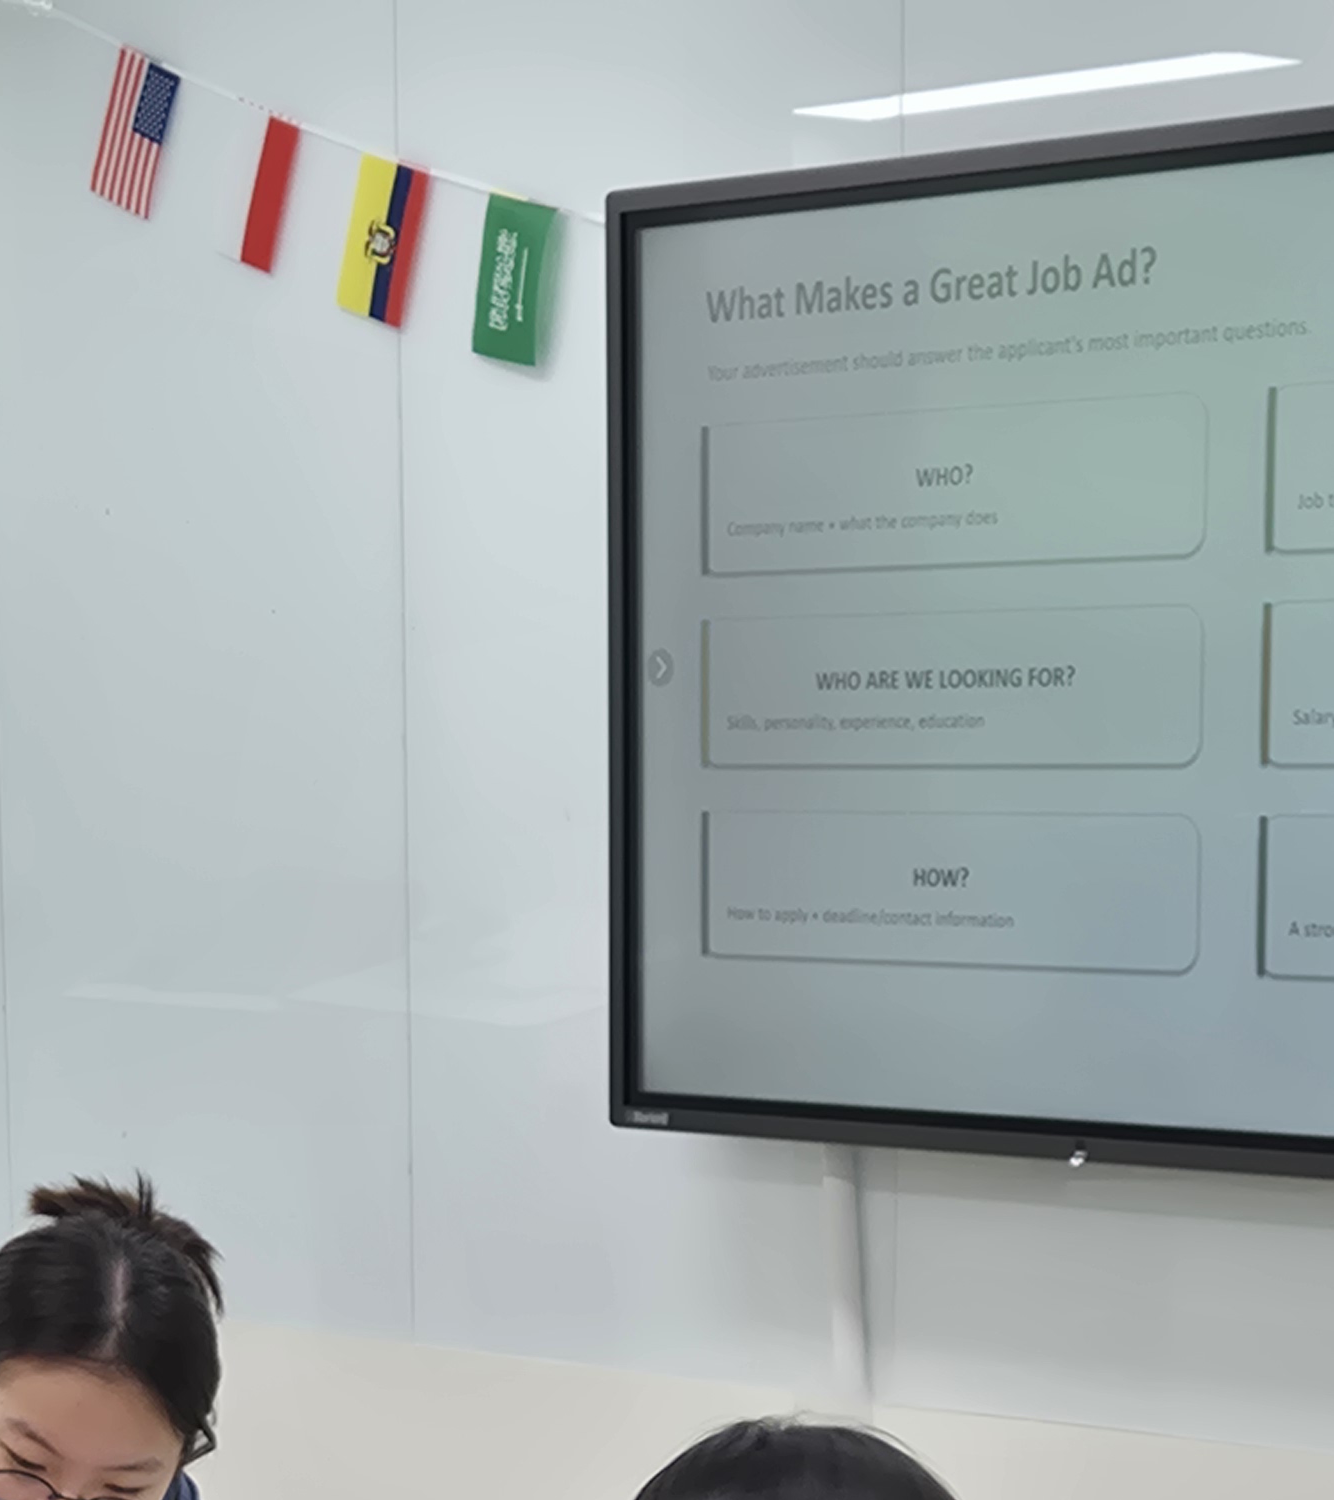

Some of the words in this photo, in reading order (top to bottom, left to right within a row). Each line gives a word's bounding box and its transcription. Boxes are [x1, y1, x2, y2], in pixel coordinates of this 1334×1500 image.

[706, 286, 785, 323] What
[794, 277, 893, 316] Makes
[902, 280, 919, 307] a
[929, 264, 1018, 304] Great
[1026, 253, 1083, 297] Job
[1092, 246, 1159, 290] Ad?
[707, 364, 739, 382] Your
[741, 354, 849, 379] advertisement
[852, 350, 904, 372] should
[908, 349, 963, 367] answer
[966, 345, 995, 363] the
[997, 334, 1084, 362] applicant's
[1088, 332, 1130, 351] most
[1133, 327, 1218, 355] important
[1223, 319, 1312, 344] questions.
[915, 463, 974, 488] WHO?
[1297, 491, 1324, 510] Job
[727, 521, 785, 538] Company
[788, 520, 824, 533] name
[839, 516, 871, 530] what
[875, 514, 897, 529] the
[900, 514, 962, 531] company
[965, 510, 998, 526] does
[815, 671, 861, 691] WHO
[865, 670, 899, 690] ARE
[904, 669, 934, 689] WE
[939, 667, 1023, 688] LOOKING
[1028, 664, 1075, 688] FOR?
[764, 714, 835, 732] personality,
[839, 715, 915, 732] experience,
[918, 714, 985, 729] education
[912, 866, 969, 888] HOW?
[727, 906, 755, 921] How
[758, 907, 771, 921] to
[774, 908, 808, 925] apply
[822, 907, 932, 927] deadline/contact
[935, 912, 1014, 929] information
[1288, 922, 1302, 938] A
